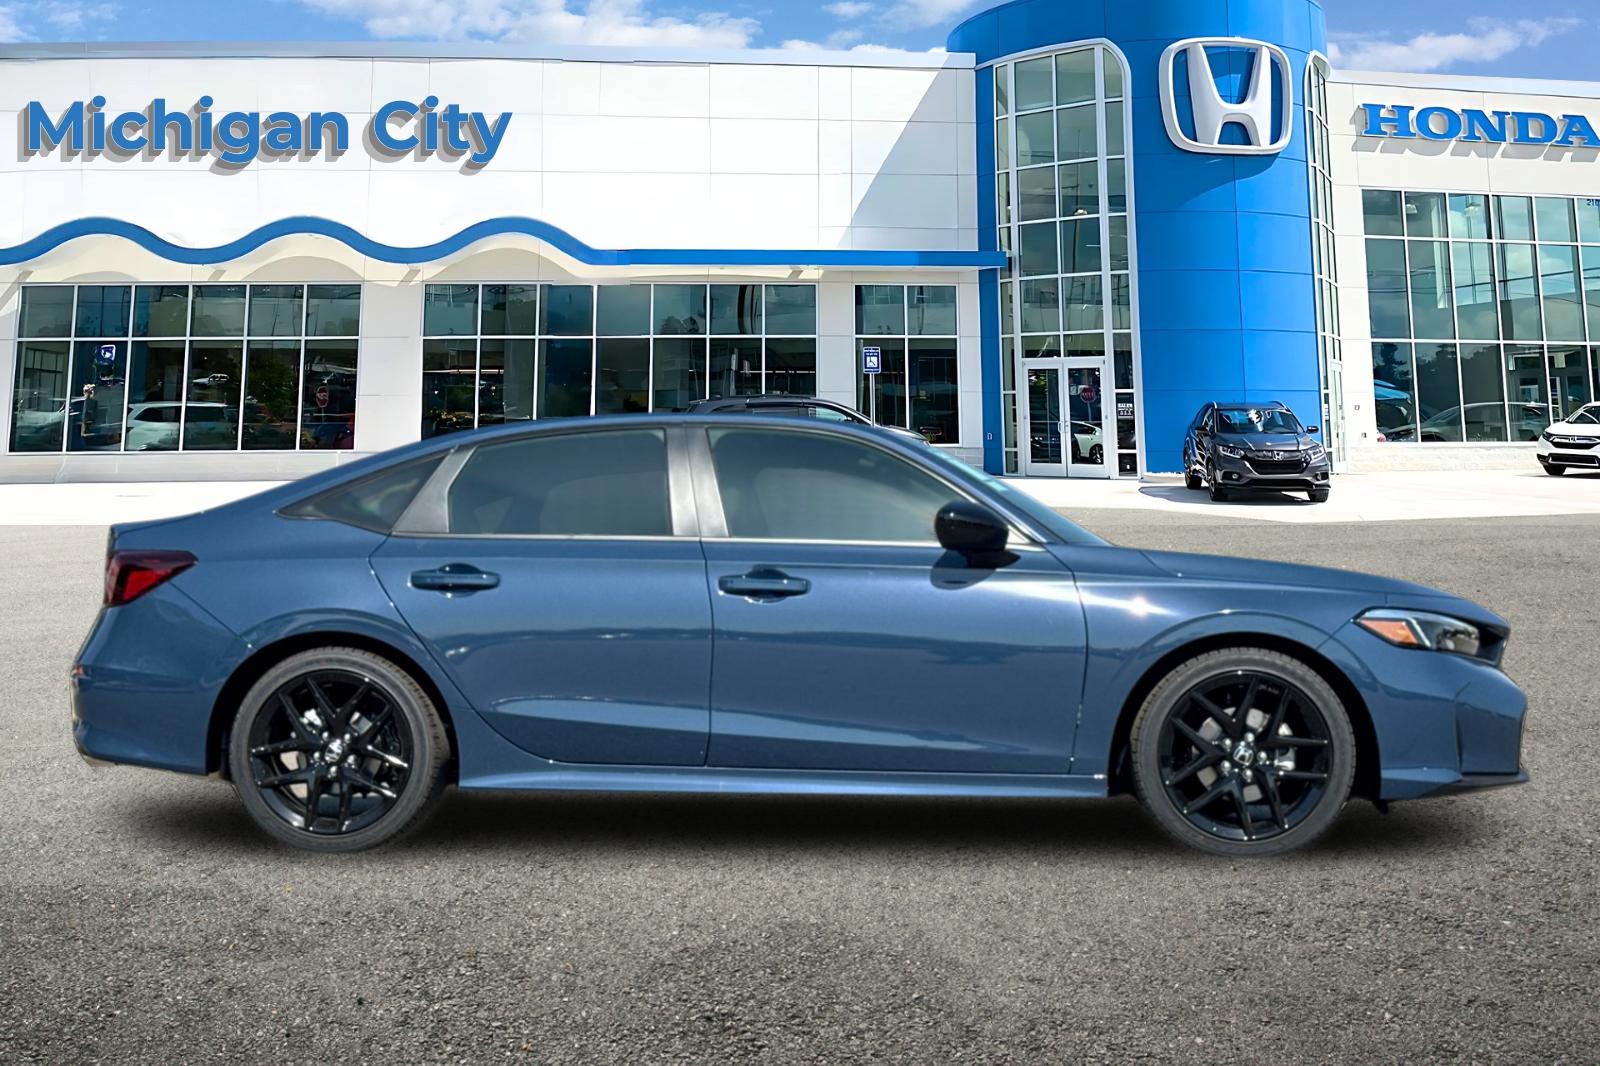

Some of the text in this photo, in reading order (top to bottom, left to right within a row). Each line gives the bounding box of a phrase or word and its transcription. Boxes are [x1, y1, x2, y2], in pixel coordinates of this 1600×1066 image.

[28, 95, 514, 164] Michigan City
[1361, 103, 1600, 147] HONDA
